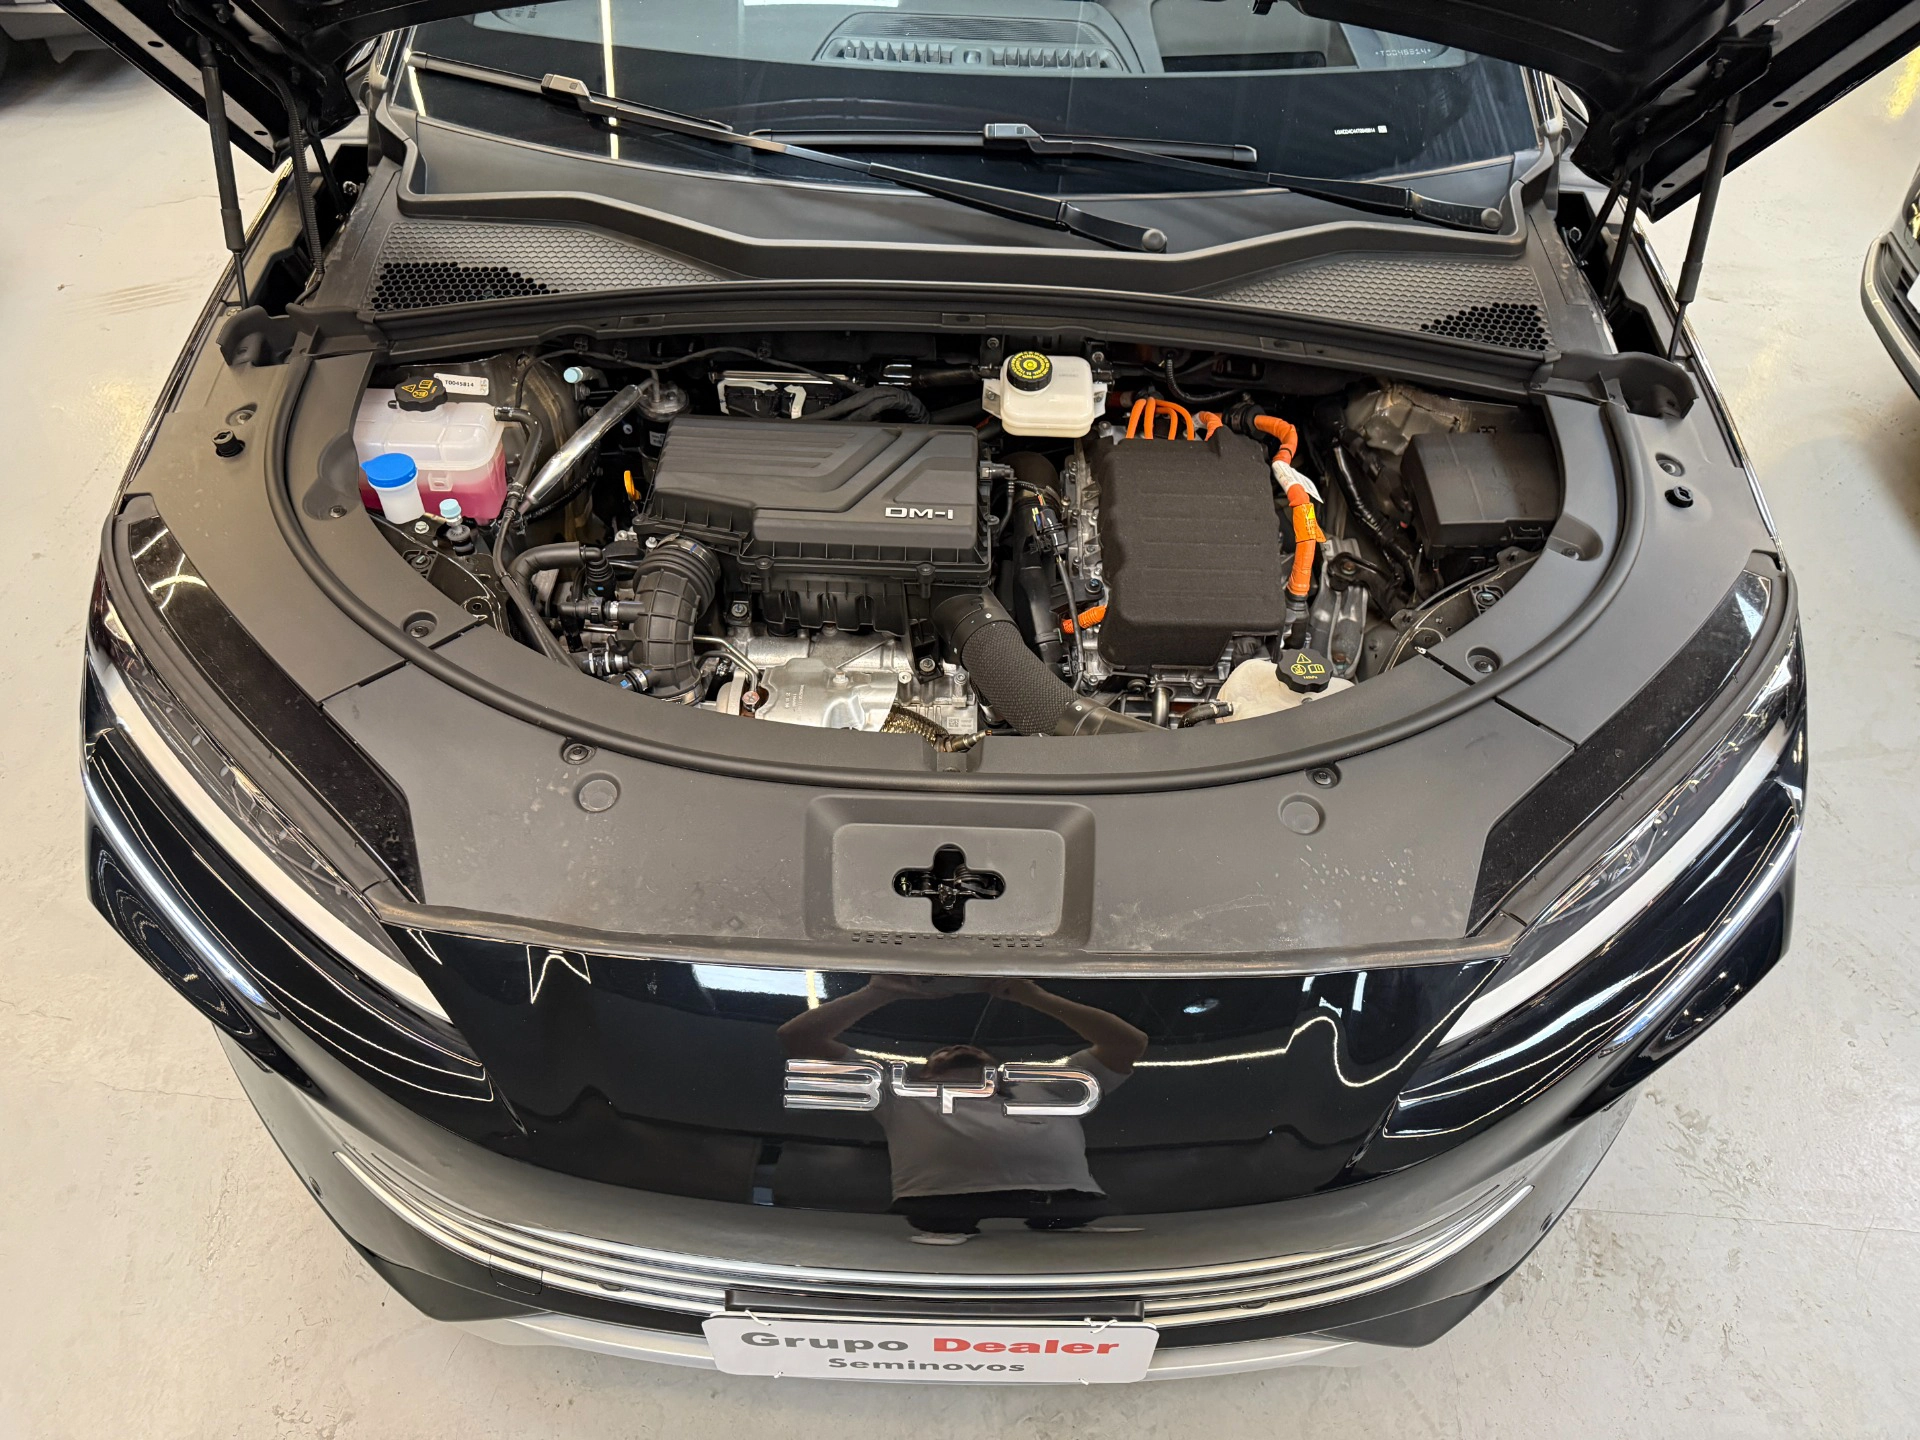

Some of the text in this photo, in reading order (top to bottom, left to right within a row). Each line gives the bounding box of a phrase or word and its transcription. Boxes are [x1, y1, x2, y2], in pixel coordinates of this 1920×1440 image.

[783, 1058, 1103, 1117] BYD
[740, 1331, 1121, 1355] Grupo Dealer
[828, 1357, 1026, 1373] Seminovos
